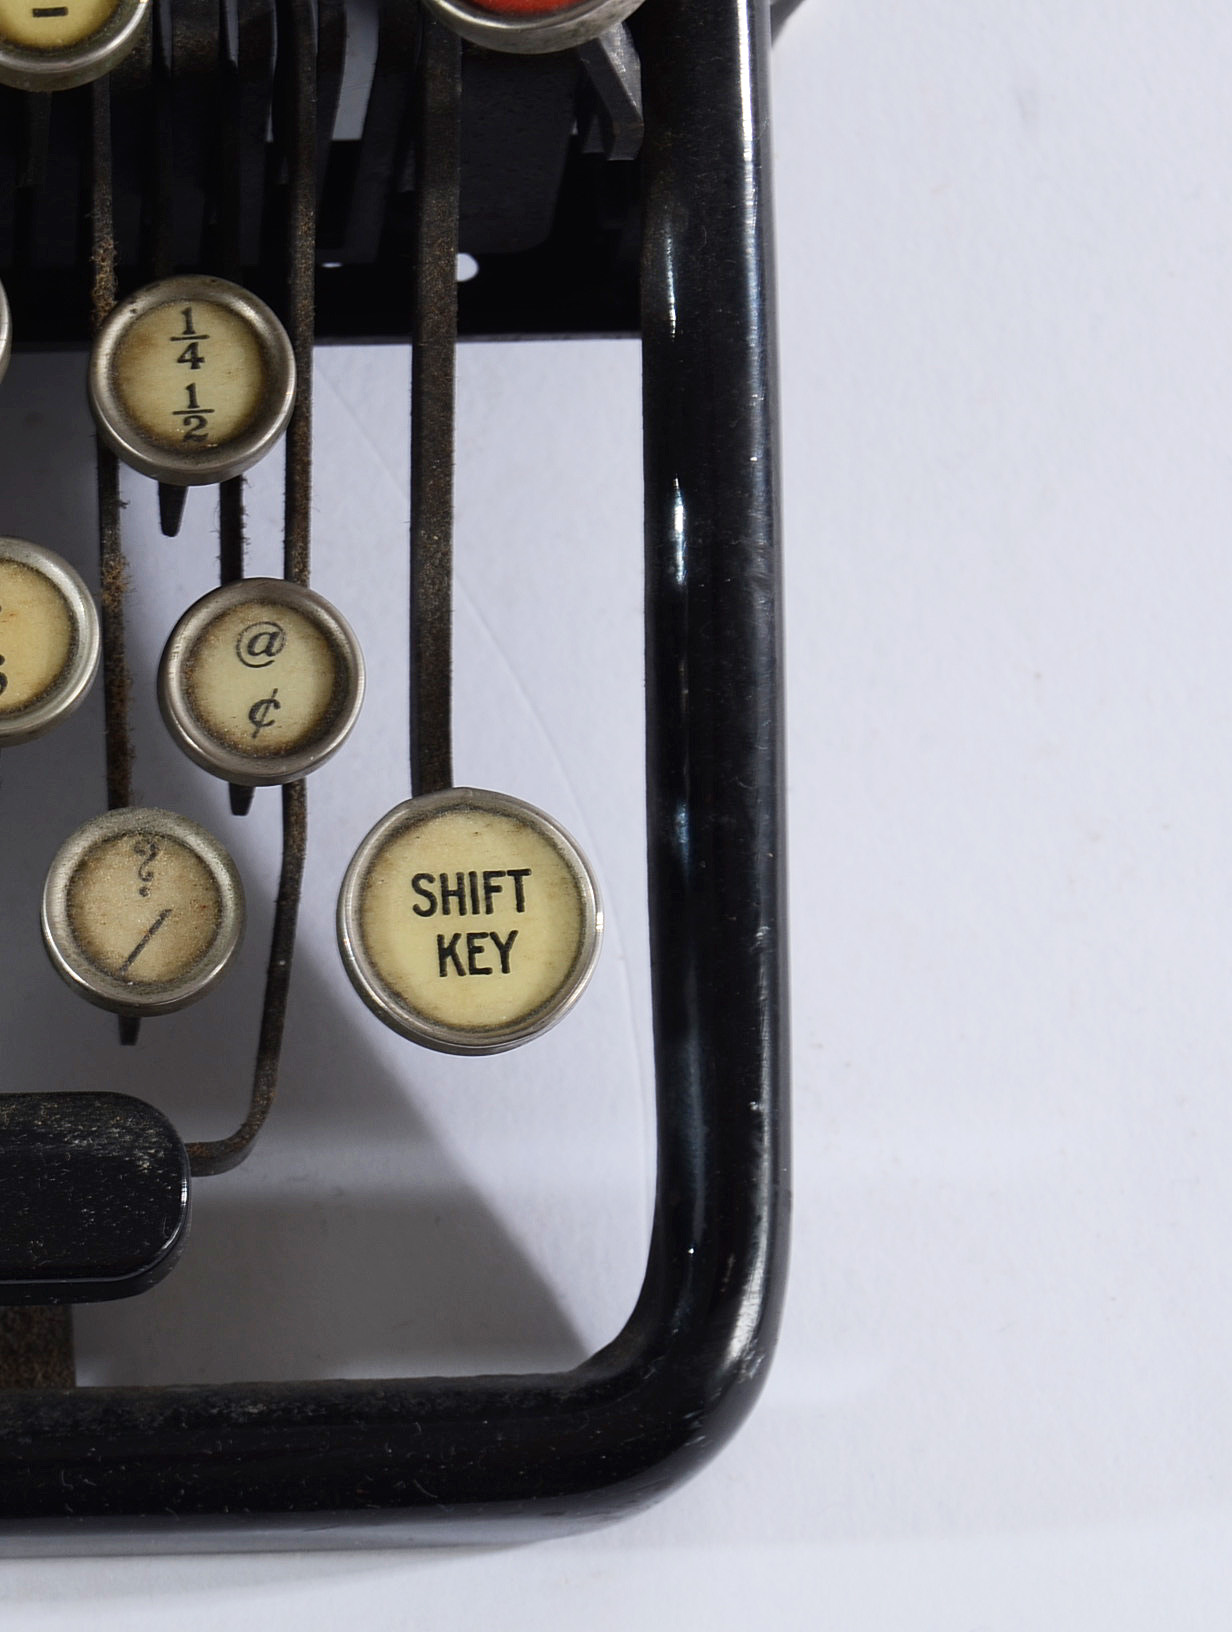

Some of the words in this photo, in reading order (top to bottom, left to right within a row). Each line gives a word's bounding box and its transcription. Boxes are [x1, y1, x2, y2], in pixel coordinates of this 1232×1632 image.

[235, 621, 286, 668] @
[412, 869, 531, 917] SHIFT
[437, 930, 518, 977] KEY
